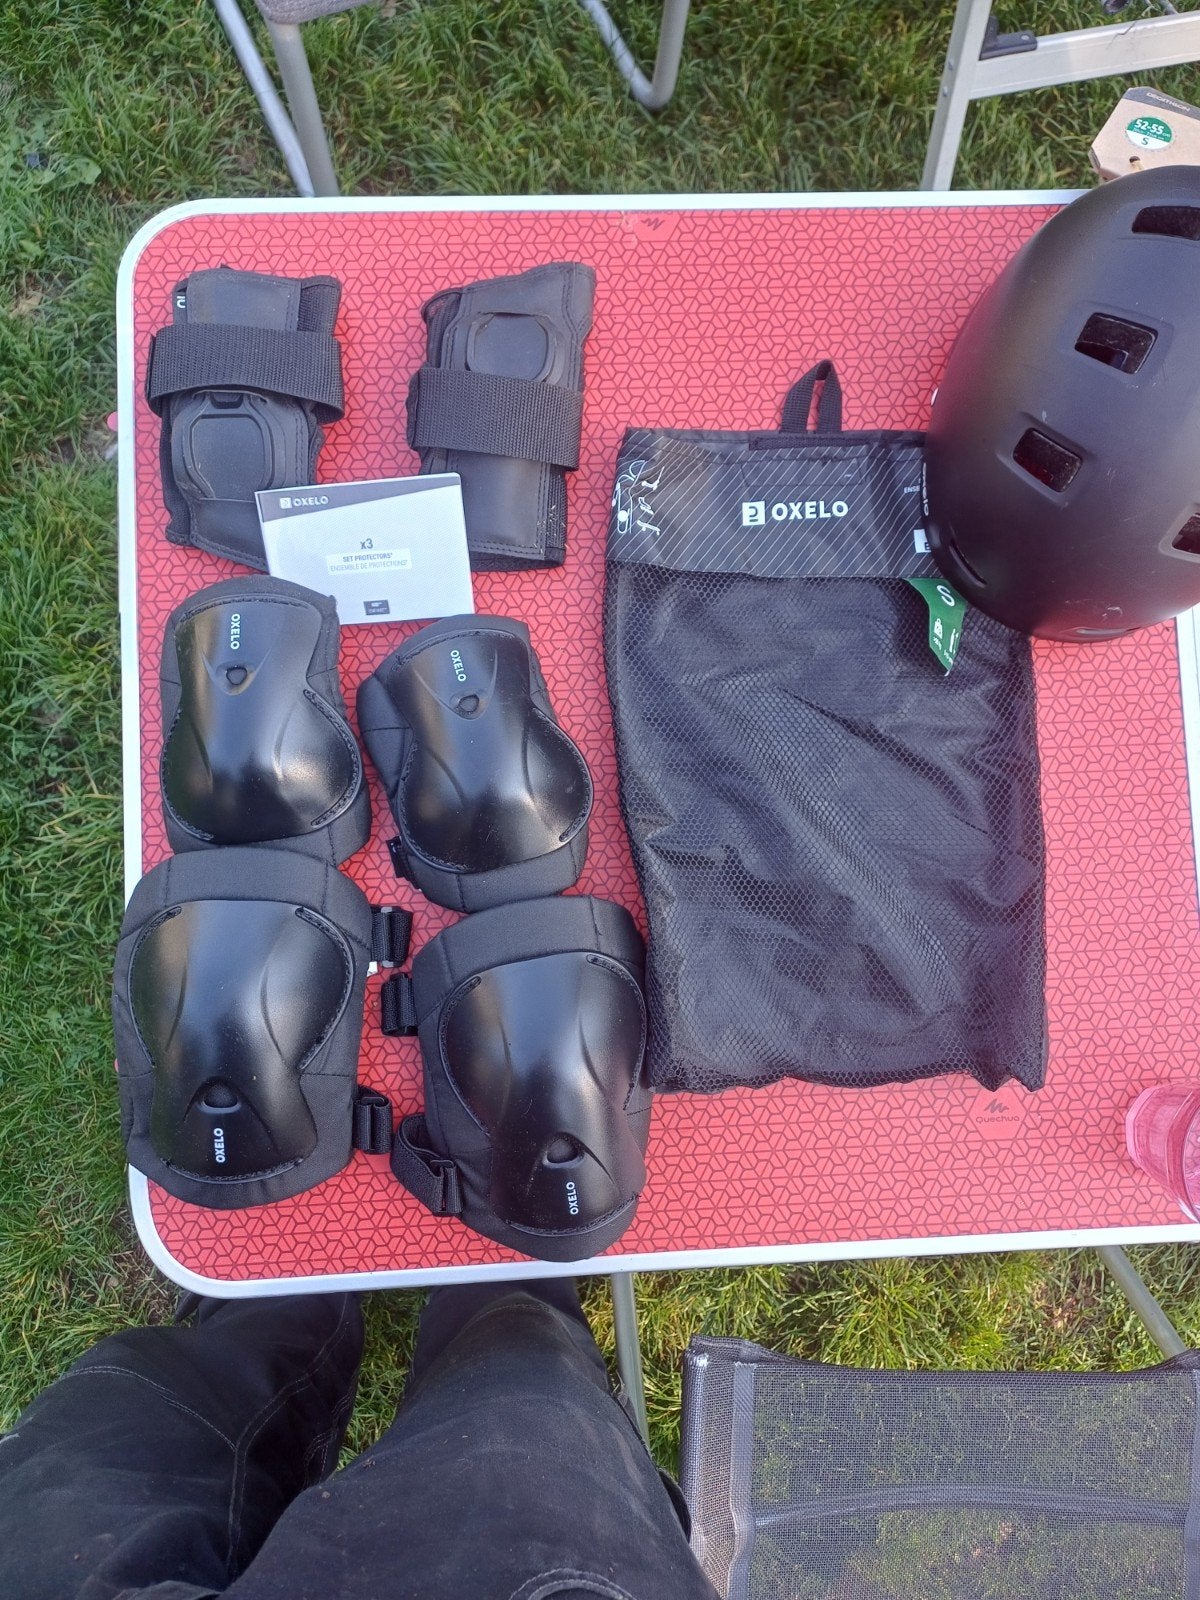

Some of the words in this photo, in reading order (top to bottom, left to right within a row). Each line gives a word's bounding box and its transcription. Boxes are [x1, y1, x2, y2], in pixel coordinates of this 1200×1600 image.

[1134, 119, 1164, 134] 52-55
[1141, 137, 1149, 146] S
[293, 495, 329, 507] OXELO
[771, 500, 849, 521] OXELO
[360, 538, 374, 550] x3
[342, 555, 354, 563] SET
[230, 613, 241, 650] OXELO
[450, 649, 467, 682] OXELO
[975, 1115, 1020, 1124] Quechua
[213, 1127, 226, 1163] OXELO
[565, 1181, 579, 1215] OXELO
